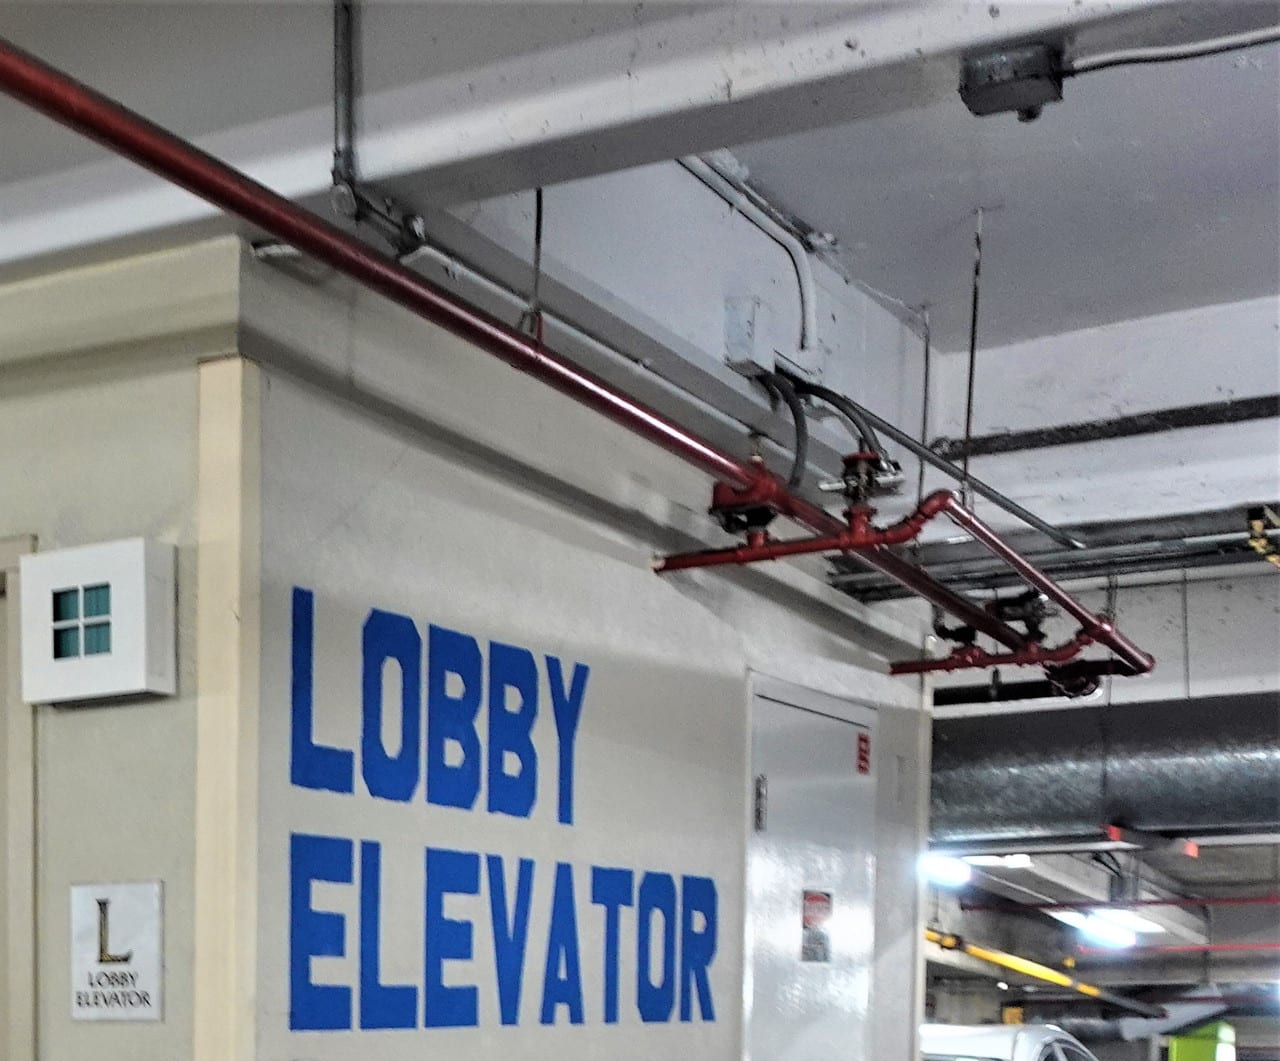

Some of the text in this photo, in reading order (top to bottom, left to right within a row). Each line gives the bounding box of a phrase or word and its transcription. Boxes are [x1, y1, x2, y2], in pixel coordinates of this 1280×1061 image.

[290, 586, 590, 825] LOBBY
[95, 898, 134, 963] L
[289, 832, 719, 1031] ELEVATOR
[76, 990, 152, 1008] ELEVATOR
[87, 970, 139, 988] LOBBY
